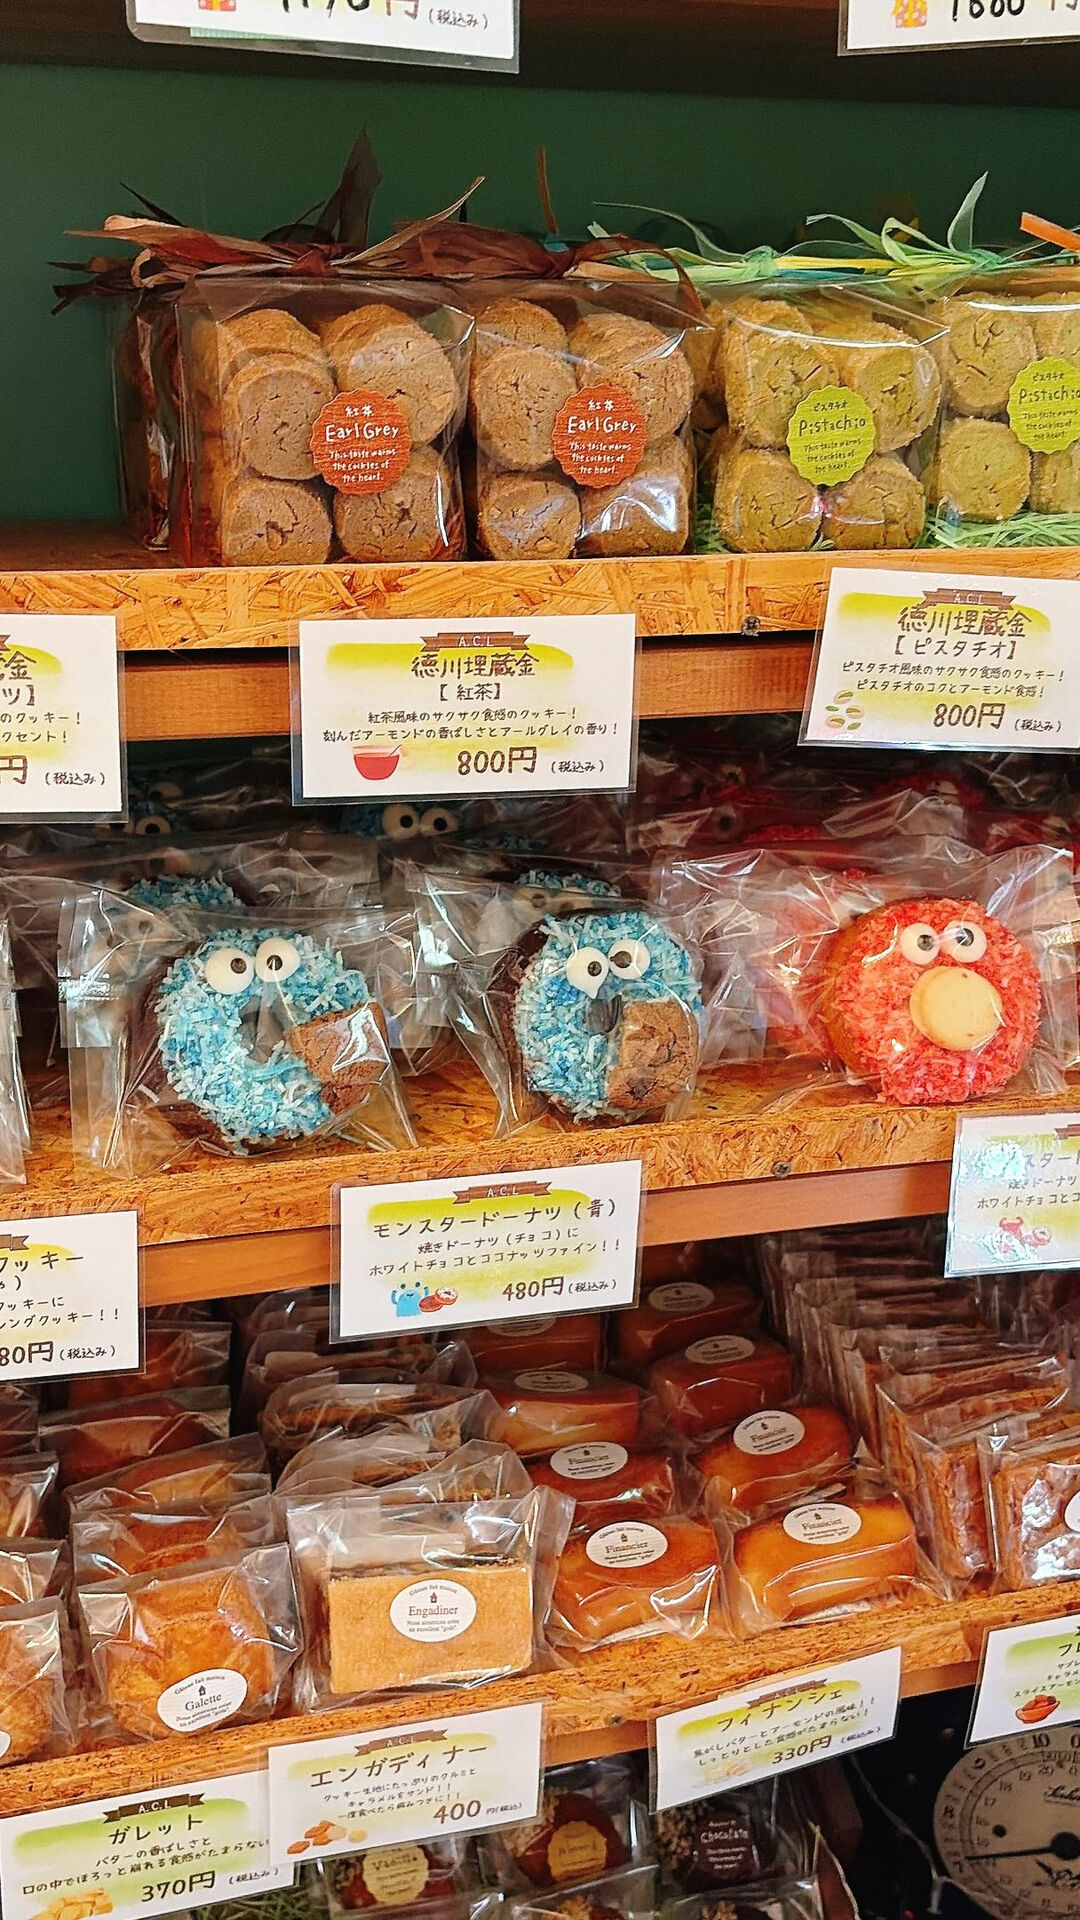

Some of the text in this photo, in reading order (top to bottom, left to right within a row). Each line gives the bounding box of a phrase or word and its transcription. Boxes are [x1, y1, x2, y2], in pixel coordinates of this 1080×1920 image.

[325, 422, 399, 442] Earl Grey
[568, 416, 636, 433] Earl Grey
[897, 604, 1032, 638] 徳川埋蔵金
[895, 635, 1017, 660] 【ピスタチオ】
[411, 653, 540, 679] 徳川埋蔵金
[842, 661, 1065, 682] ピスタチオ風味のサクサク食感のクッキー！
[439, 683, 501, 702] 【紅茶】
[857, 678, 1044, 698] ピスタチオのコクとアーモンド食感！
[368, 707, 576, 724] 紅茶風味のサクサク食感のクッキー！
[933, 702, 1006, 730] 800円
[323, 723, 618, 742] 刻んだアーモンドの香ばしさとアールグレイの香り！
[457, 746, 604, 776] 800円 （税込み）
[417, 1226, 579, 1255] 焼きドーナツ（チョコ）に
[501, 1276, 564, 1302] 480円
[408, 1605, 459, 1618] Engadiner
[184, 1694, 222, 1711] Galette
[717, 1689, 844, 1732] フィナンシェ
[772, 1735, 832, 1765] 330円
[310, 1745, 488, 1788] エンガディナー
[433, 1800, 481, 1824] 400
[108, 1815, 203, 1844] ガレット
[96, 1837, 212, 1867] バターの香ばしさと
[141, 1870, 215, 1903] 370円
